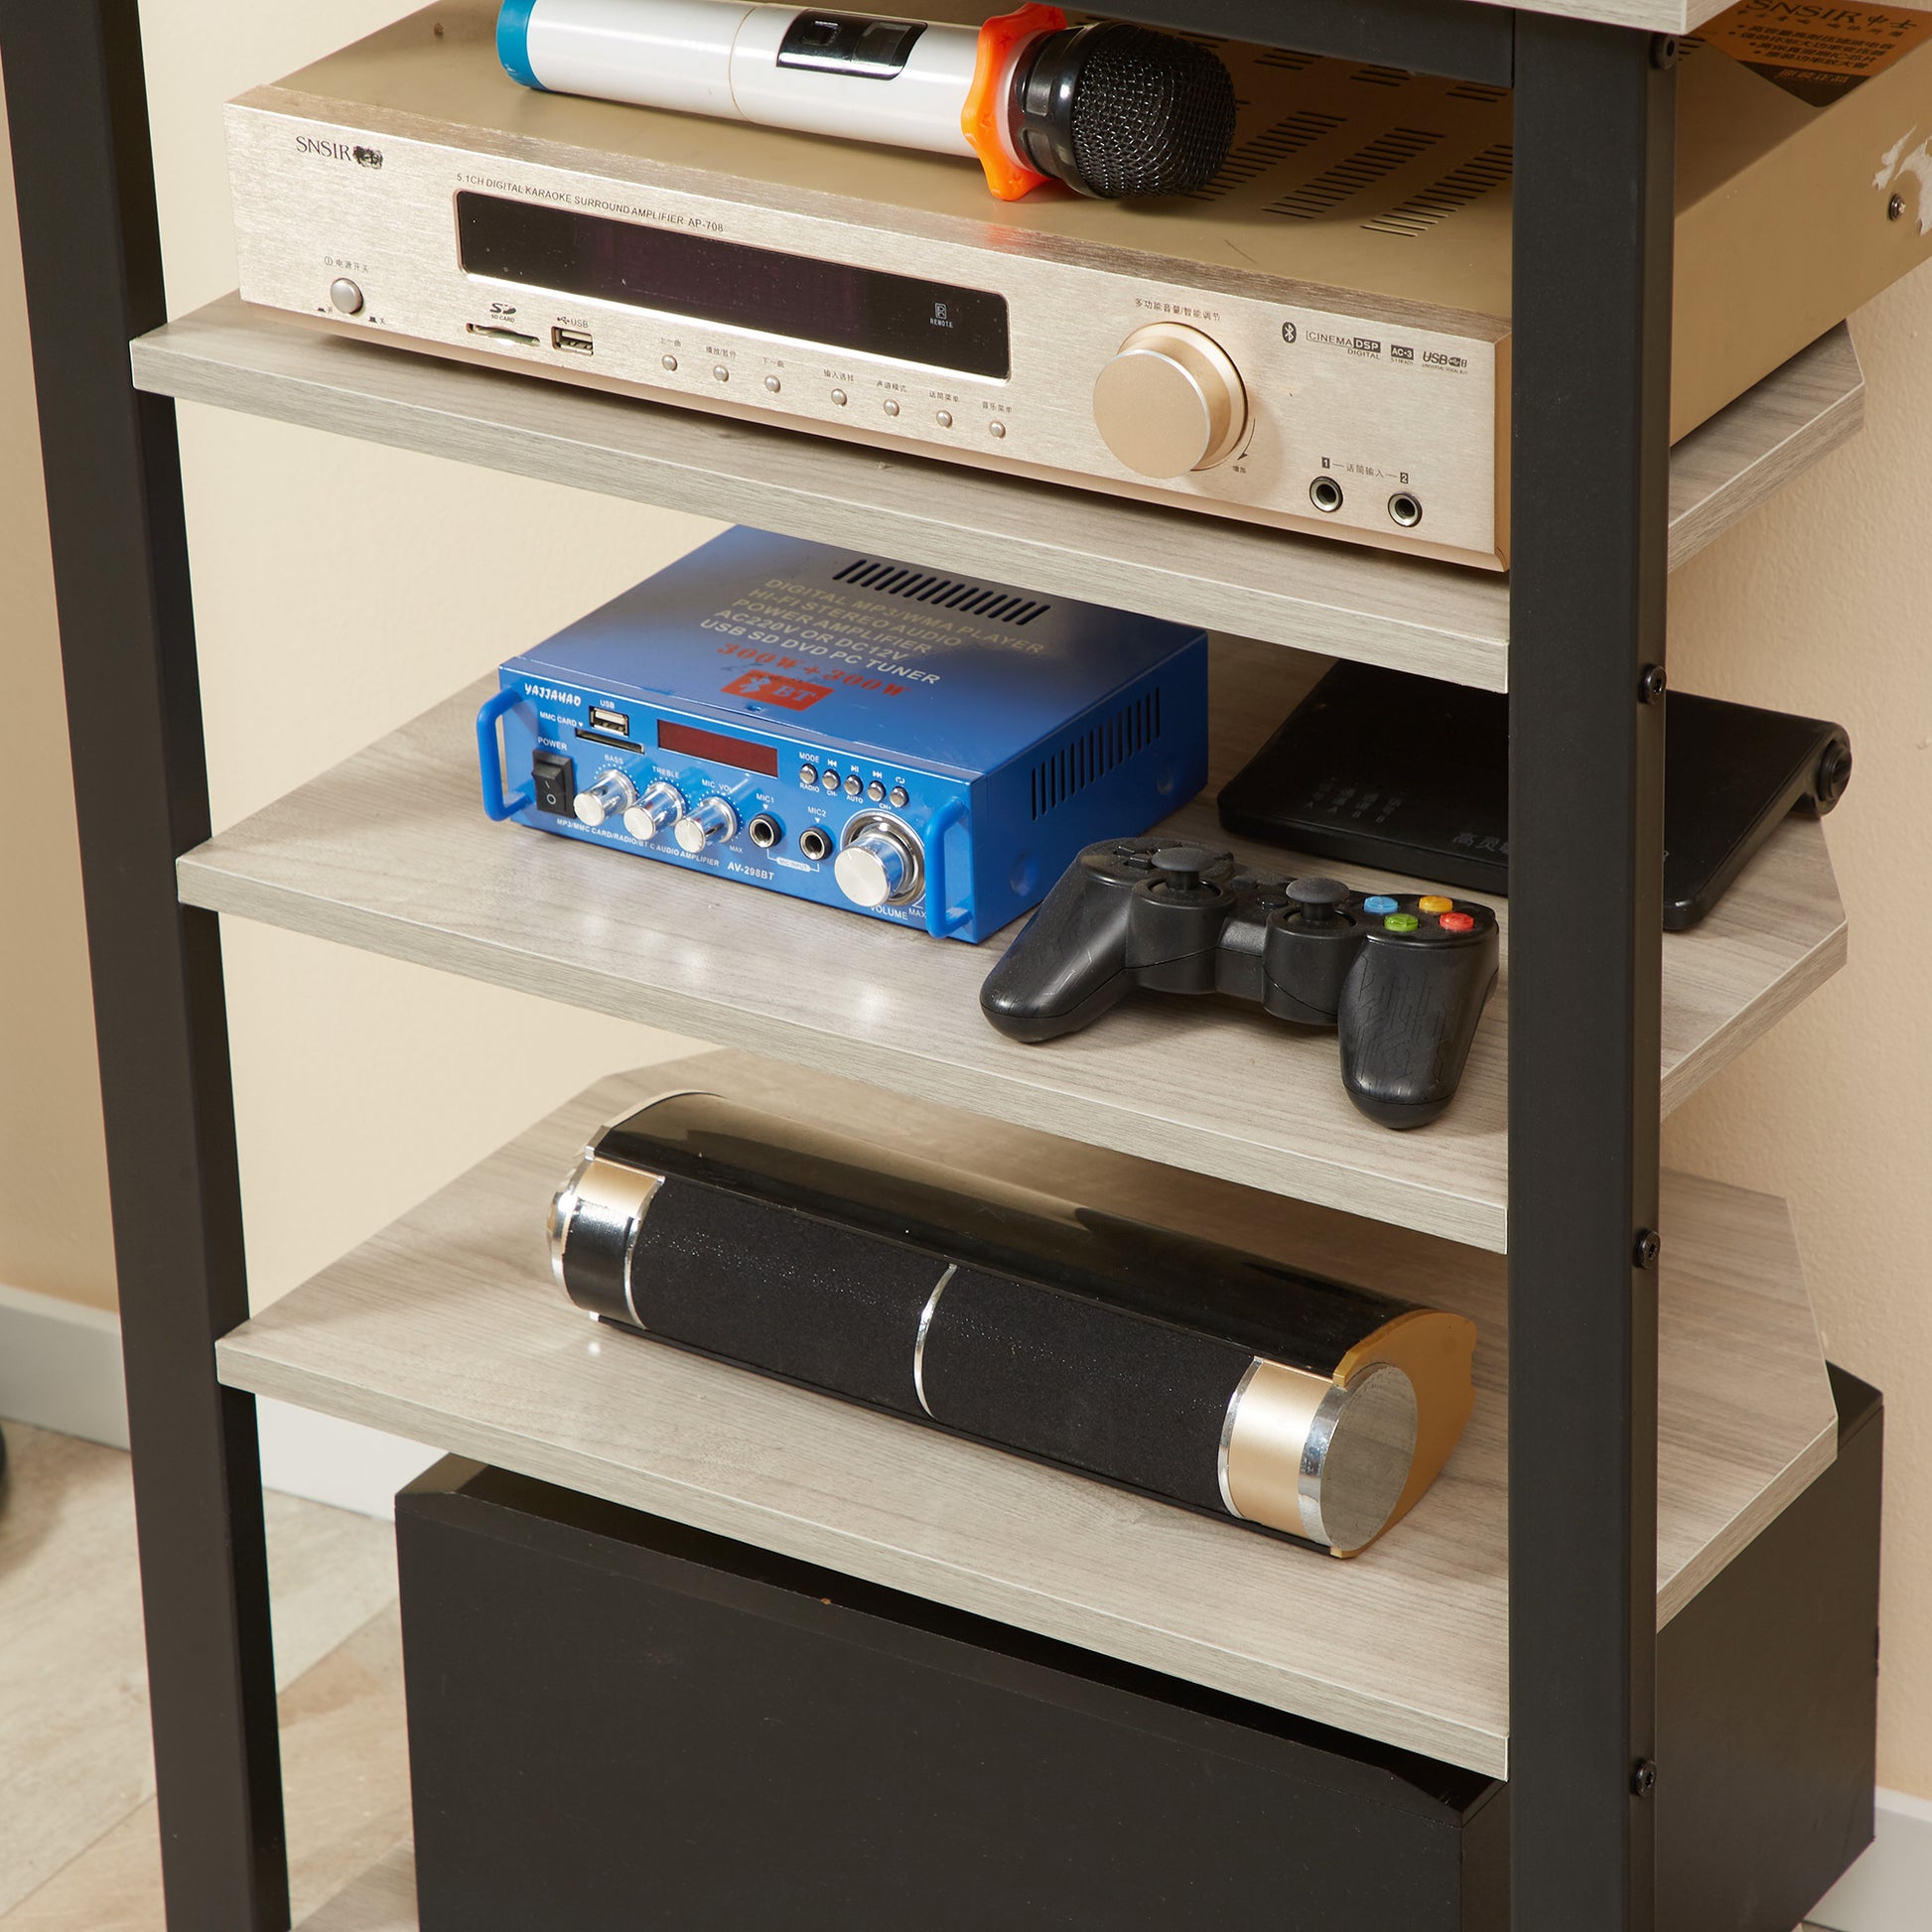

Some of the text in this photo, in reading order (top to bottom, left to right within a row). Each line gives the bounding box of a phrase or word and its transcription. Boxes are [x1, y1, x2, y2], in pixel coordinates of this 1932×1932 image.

[1746, 0, 1863, 23] SNSIR
[296, 136, 351, 161] SNSIR
[457, 174, 724, 232] 5.1CH DIGITAL KARAOKE SURROUND AMPLIFIER AP-708
[571, 319, 589, 328] USB
[929, 318, 953, 329] REMOTE
[1309, 331, 1380, 351] CINEMA DSP
[1347, 347, 1381, 360] DIGITAL
[1423, 350, 1448, 365] USB
[749, 589, 962, 646] HI-FI STEREO AUDIO
[764, 579, 1044, 653] DIGITAL MP3/WMA PLAYER
[732, 599, 933, 653] POWER AMPLIFIER
[715, 610, 908, 660] AC220V OR DC12V
[700, 619, 941, 684] USB SD DVD PC TUNER
[773, 685, 817, 701] BT
[600, 699, 616, 710] USB
[539, 711, 577, 728] MMC CARD
[537, 737, 568, 752] POWER
[604, 754, 623, 765] BASS
[798, 752, 820, 763] MODE
[652, 766, 680, 779] TREBLE
[701, 778, 715, 788] MIC
[799, 782, 820, 793] RADIO
[756, 793, 774, 803] MIC1
[846, 794, 864, 804] AUTO
[807, 805, 827, 818] MIC2
[556, 818, 591, 833] MP3/MMC
[656, 845, 680, 857] AUDIO
[680, 852, 720, 867] AMPLIFIER
[729, 844, 744, 854] MAX
[728, 861, 774, 882] AV-298BT
